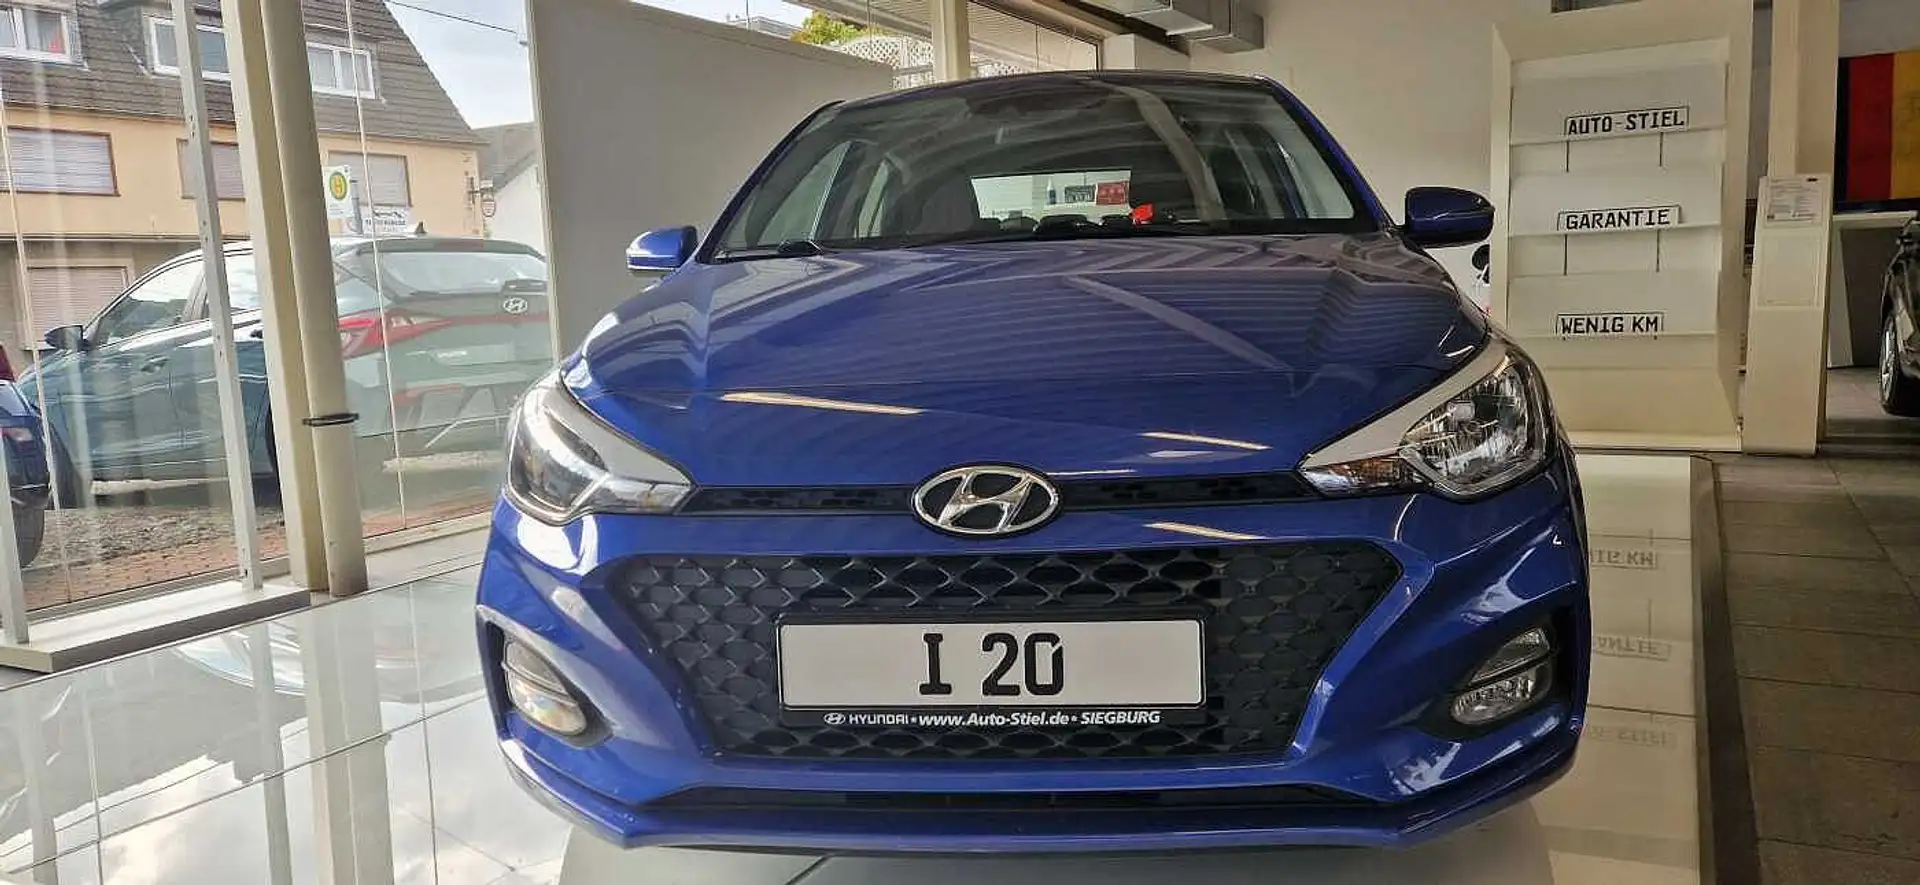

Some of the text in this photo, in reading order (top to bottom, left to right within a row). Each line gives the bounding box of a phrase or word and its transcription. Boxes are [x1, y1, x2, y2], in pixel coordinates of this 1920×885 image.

[1565, 208, 1671, 230] GARANTIE
[1561, 315, 1659, 334] WENIG KM
[919, 632, 1065, 696] I 20
[849, 710, 1161, 726] HYUNDAI www.Auto-Stiel.de SIEGBURG
